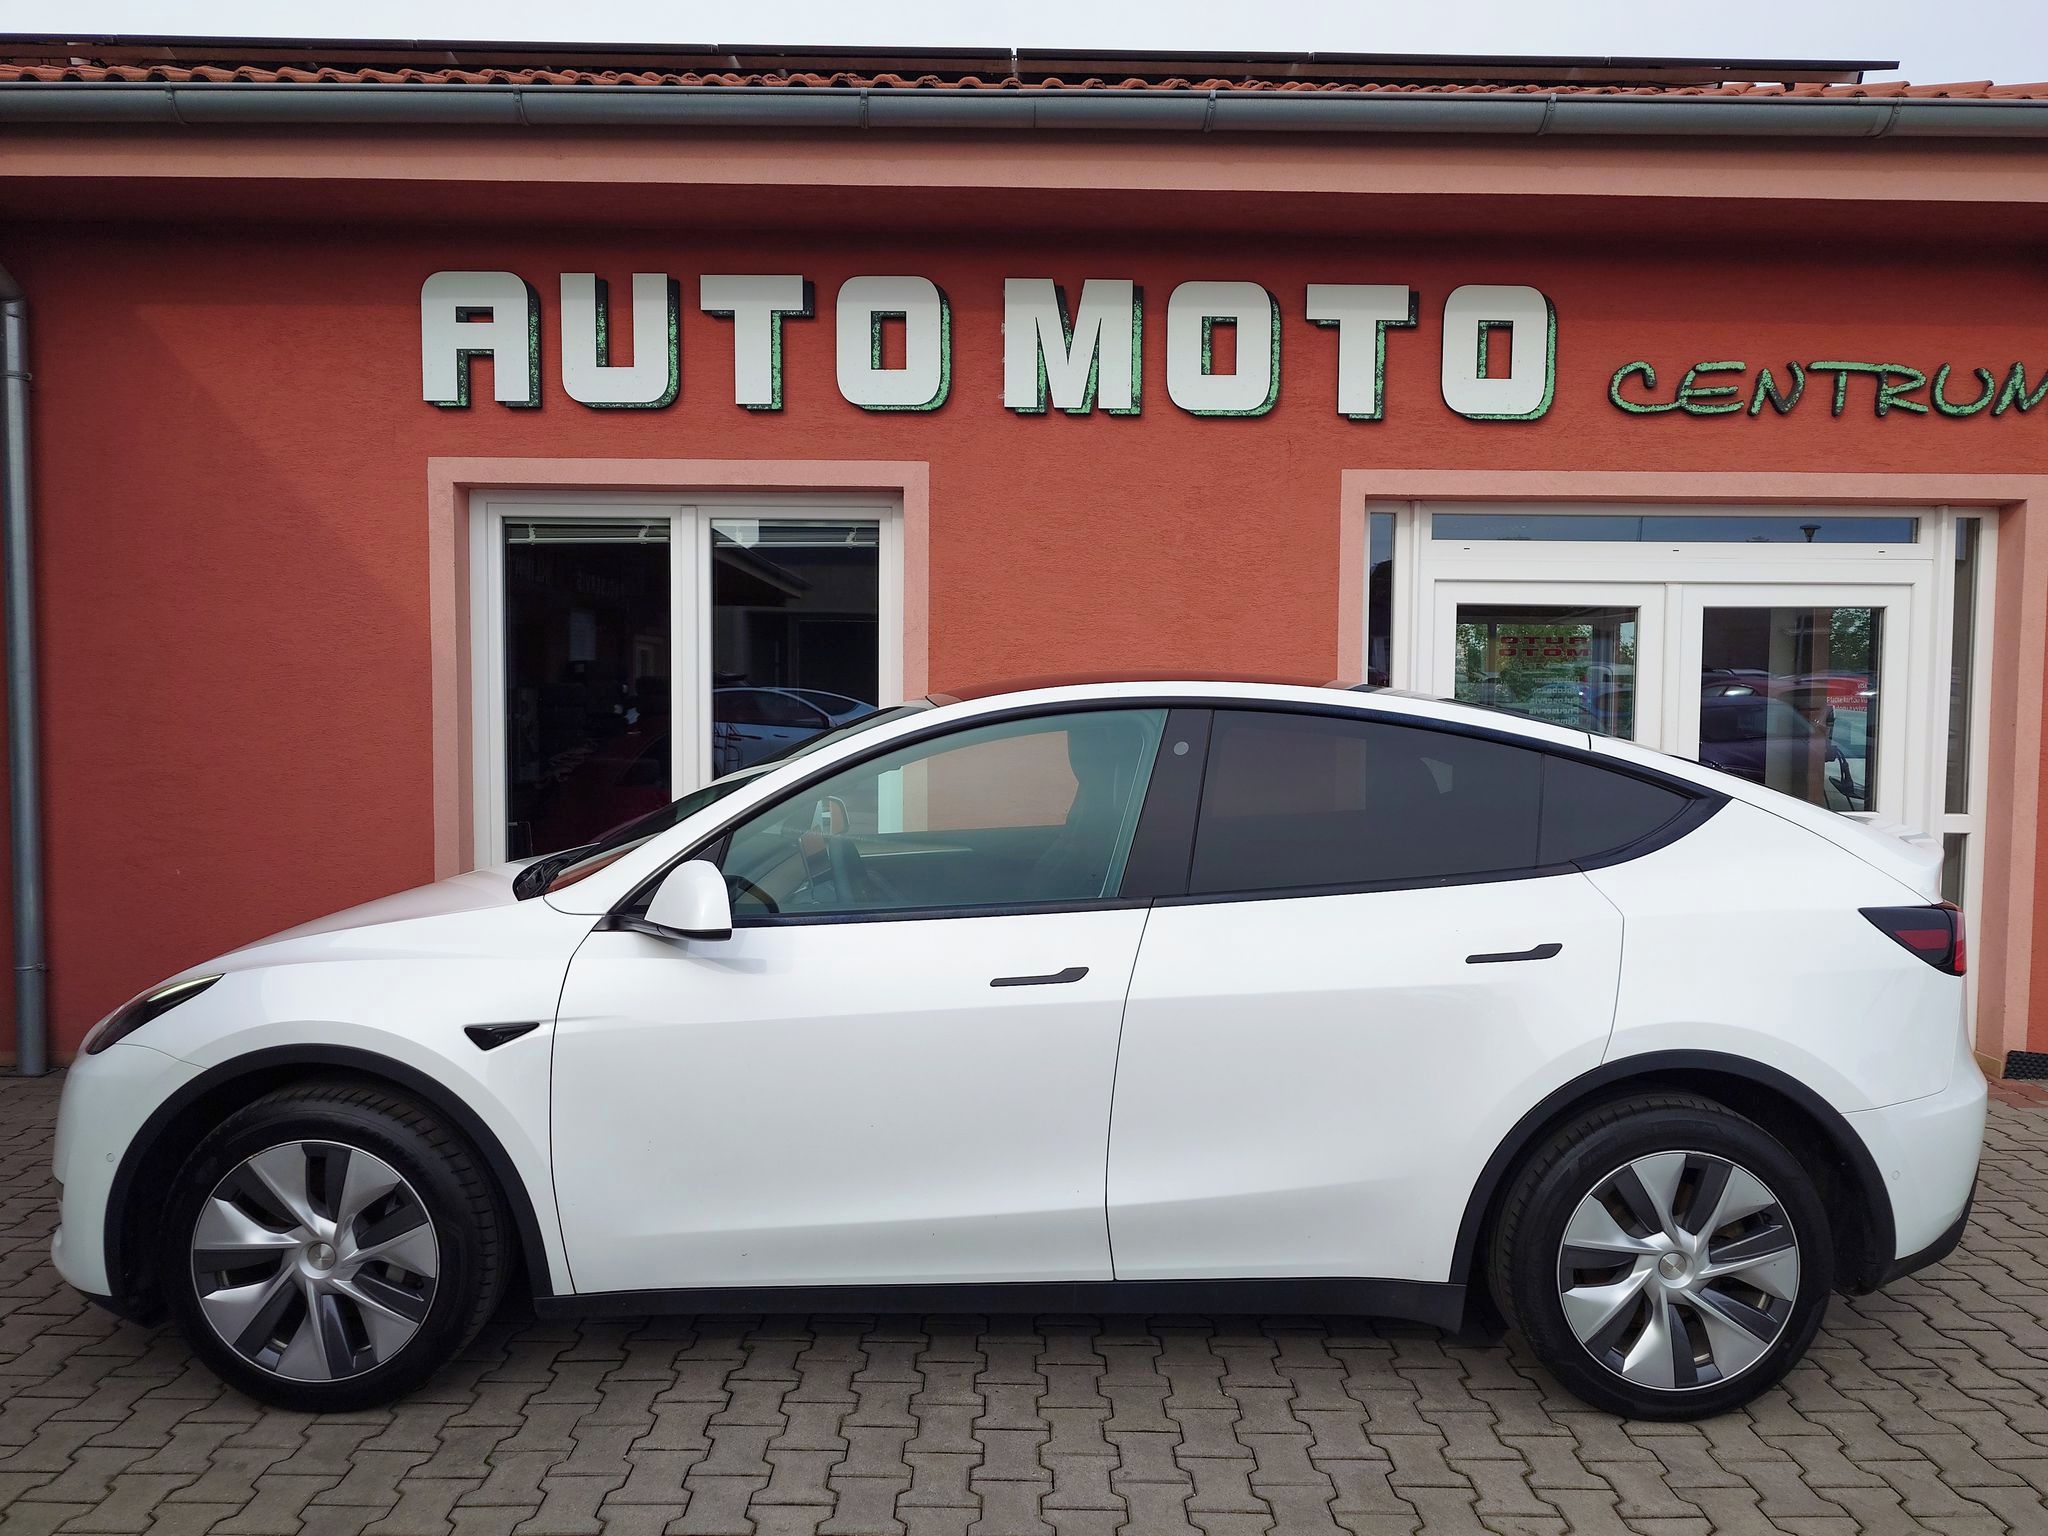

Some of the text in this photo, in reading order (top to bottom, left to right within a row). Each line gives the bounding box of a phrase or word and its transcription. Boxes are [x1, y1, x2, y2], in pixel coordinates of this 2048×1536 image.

[420, 271, 2048, 421] AUTO MOTO CENTRUM
